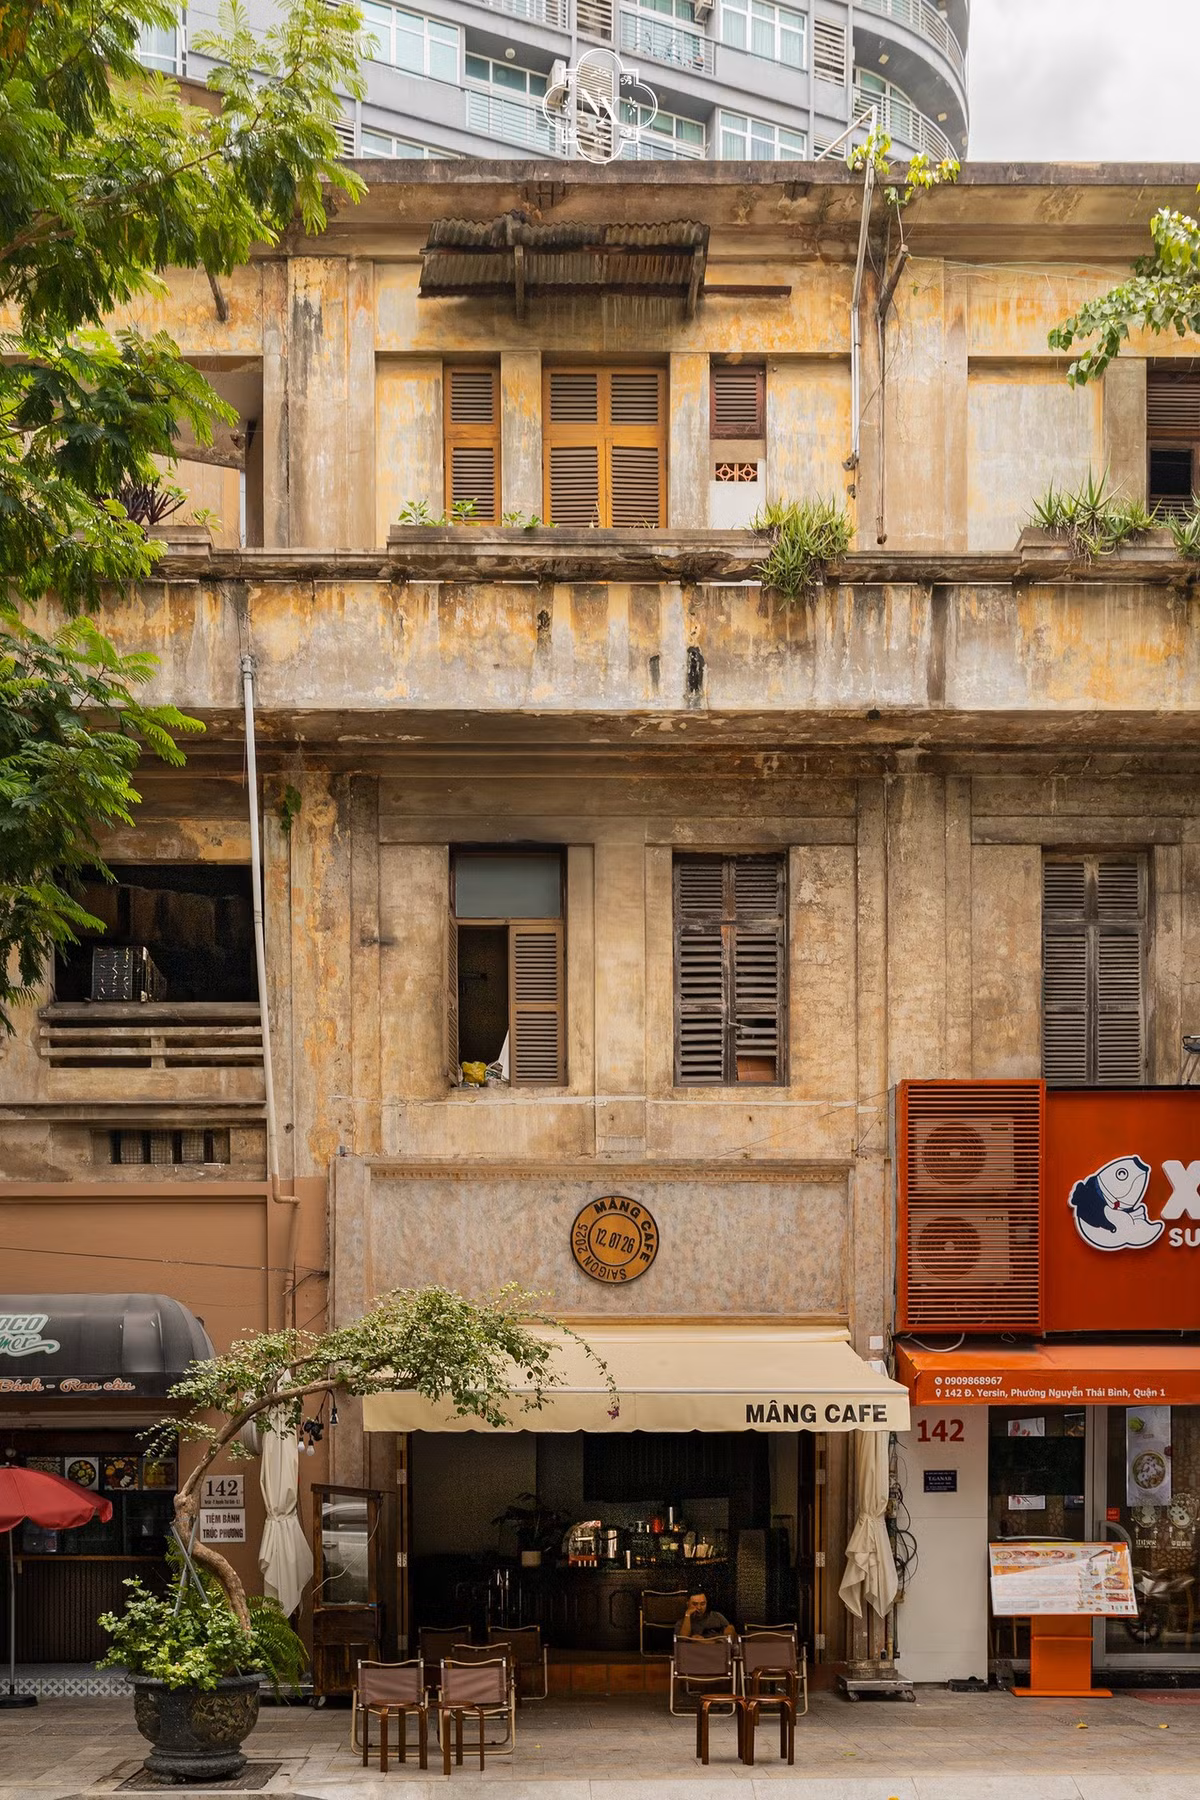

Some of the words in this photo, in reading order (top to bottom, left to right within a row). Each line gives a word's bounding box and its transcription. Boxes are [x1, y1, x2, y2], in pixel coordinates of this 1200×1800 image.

[575, 1223, 589, 1254] 2025
[593, 1197, 641, 1219] MÂNG
[639, 1220, 655, 1262] CAFE
[608, 1232, 622, 1249] 07
[620, 1236, 635, 1254] 26
[583, 1255, 627, 1280] SAIGON
[60, 1378, 101, 1392] Rau
[103, 1377, 136, 1391] câu
[944, 1376, 1003, 1385] 0909868967
[944, 1389, 962, 1397] 142
[964, 1389, 975, 1397] Đ.
[977, 1388, 1009, 1398] Yersin,
[1011, 1387, 1046, 1398] Phường
[1048, 1386, 1083, 1398] Nguyễn
[1085, 1388, 1105, 1397] Thái
[1108, 1387, 1131, 1398] Bình,
[1133, 1388, 1158, 1398] Quận
[1160, 1389, 1166, 1397] 1
[745, 1400, 817, 1424] MÂNG
[824, 1404, 888, 1424] CAFE
[916, 1419, 965, 1443] 142
[206, 1479, 239, 1497] 142
[205, 1513, 222, 1525] TIỆM
[223, 1513, 241, 1524] BÁNH
